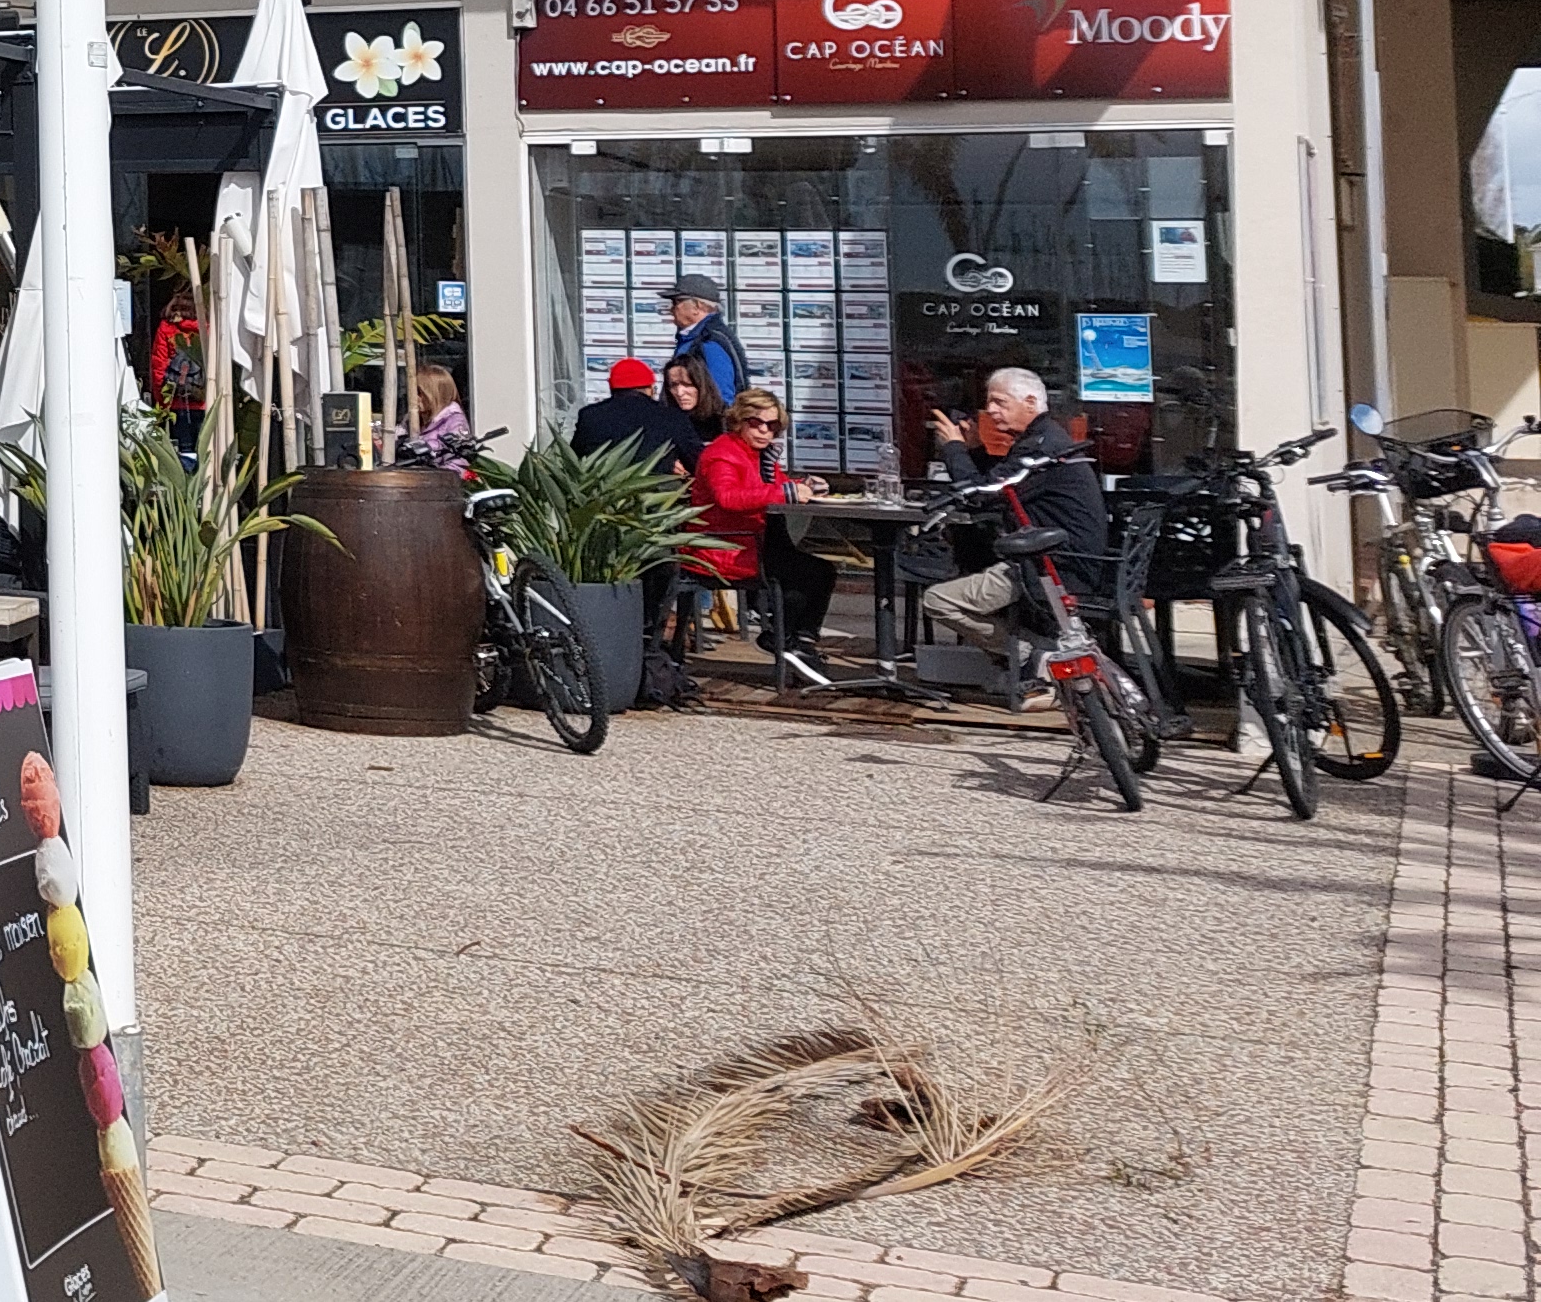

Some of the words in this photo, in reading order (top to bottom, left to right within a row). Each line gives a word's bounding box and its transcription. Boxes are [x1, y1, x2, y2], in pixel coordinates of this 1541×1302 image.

[1065, 1, 1232, 51] Moody
[785, 41, 838, 60] CAP
[850, 36, 945, 59] OCÉAN
[531, 53, 757, 78] www.cap-ocean.fr
[325, 105, 447, 130] GLACES
[922, 302, 961, 316] CAP
[970, 300, 1040, 317] OCÉAN
